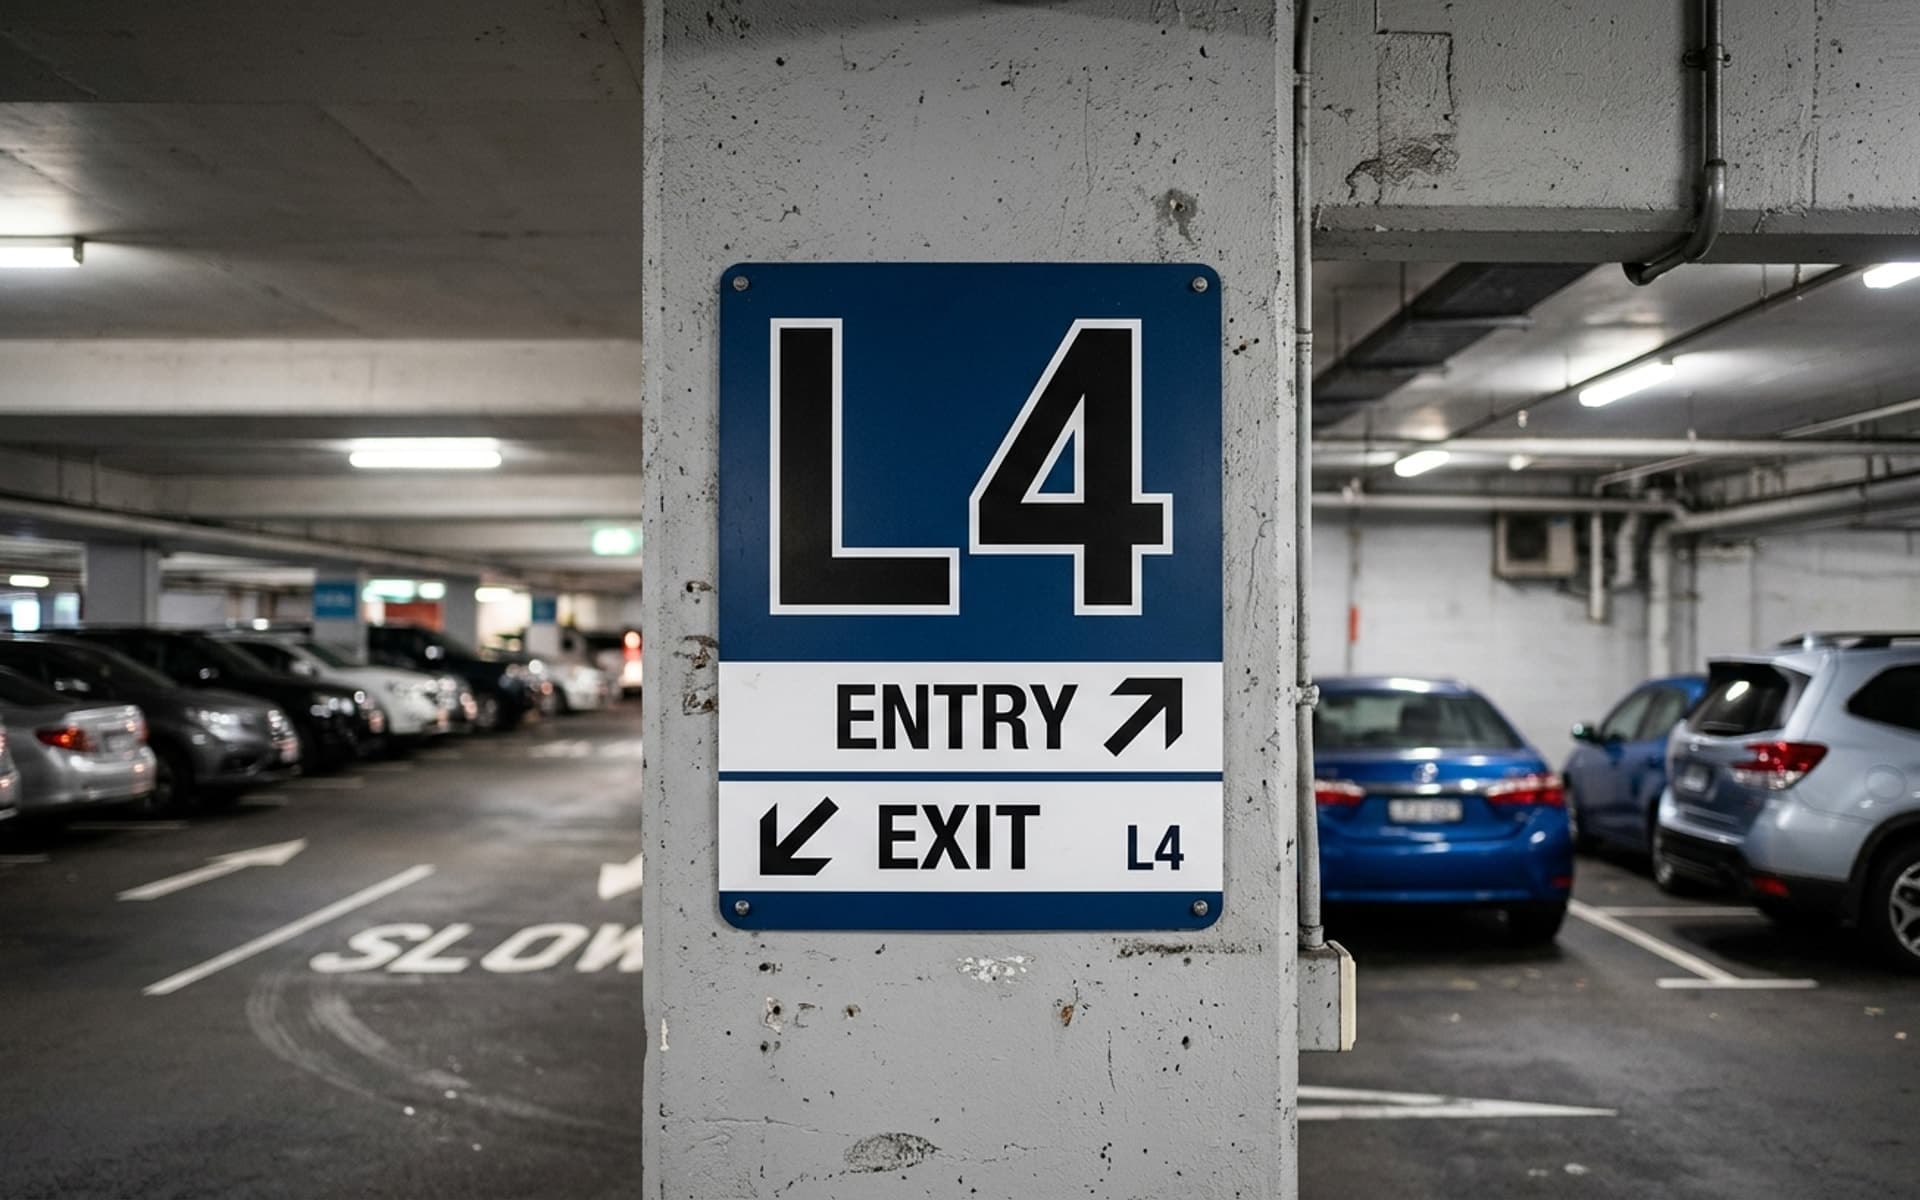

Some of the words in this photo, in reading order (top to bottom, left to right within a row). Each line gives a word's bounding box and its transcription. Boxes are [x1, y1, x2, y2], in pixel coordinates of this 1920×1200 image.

[769, 318, 1174, 616] L4
[836, 683, 1079, 750] ENTRY
[878, 804, 1041, 871] EXIT
[1127, 824, 1186, 871] L4
